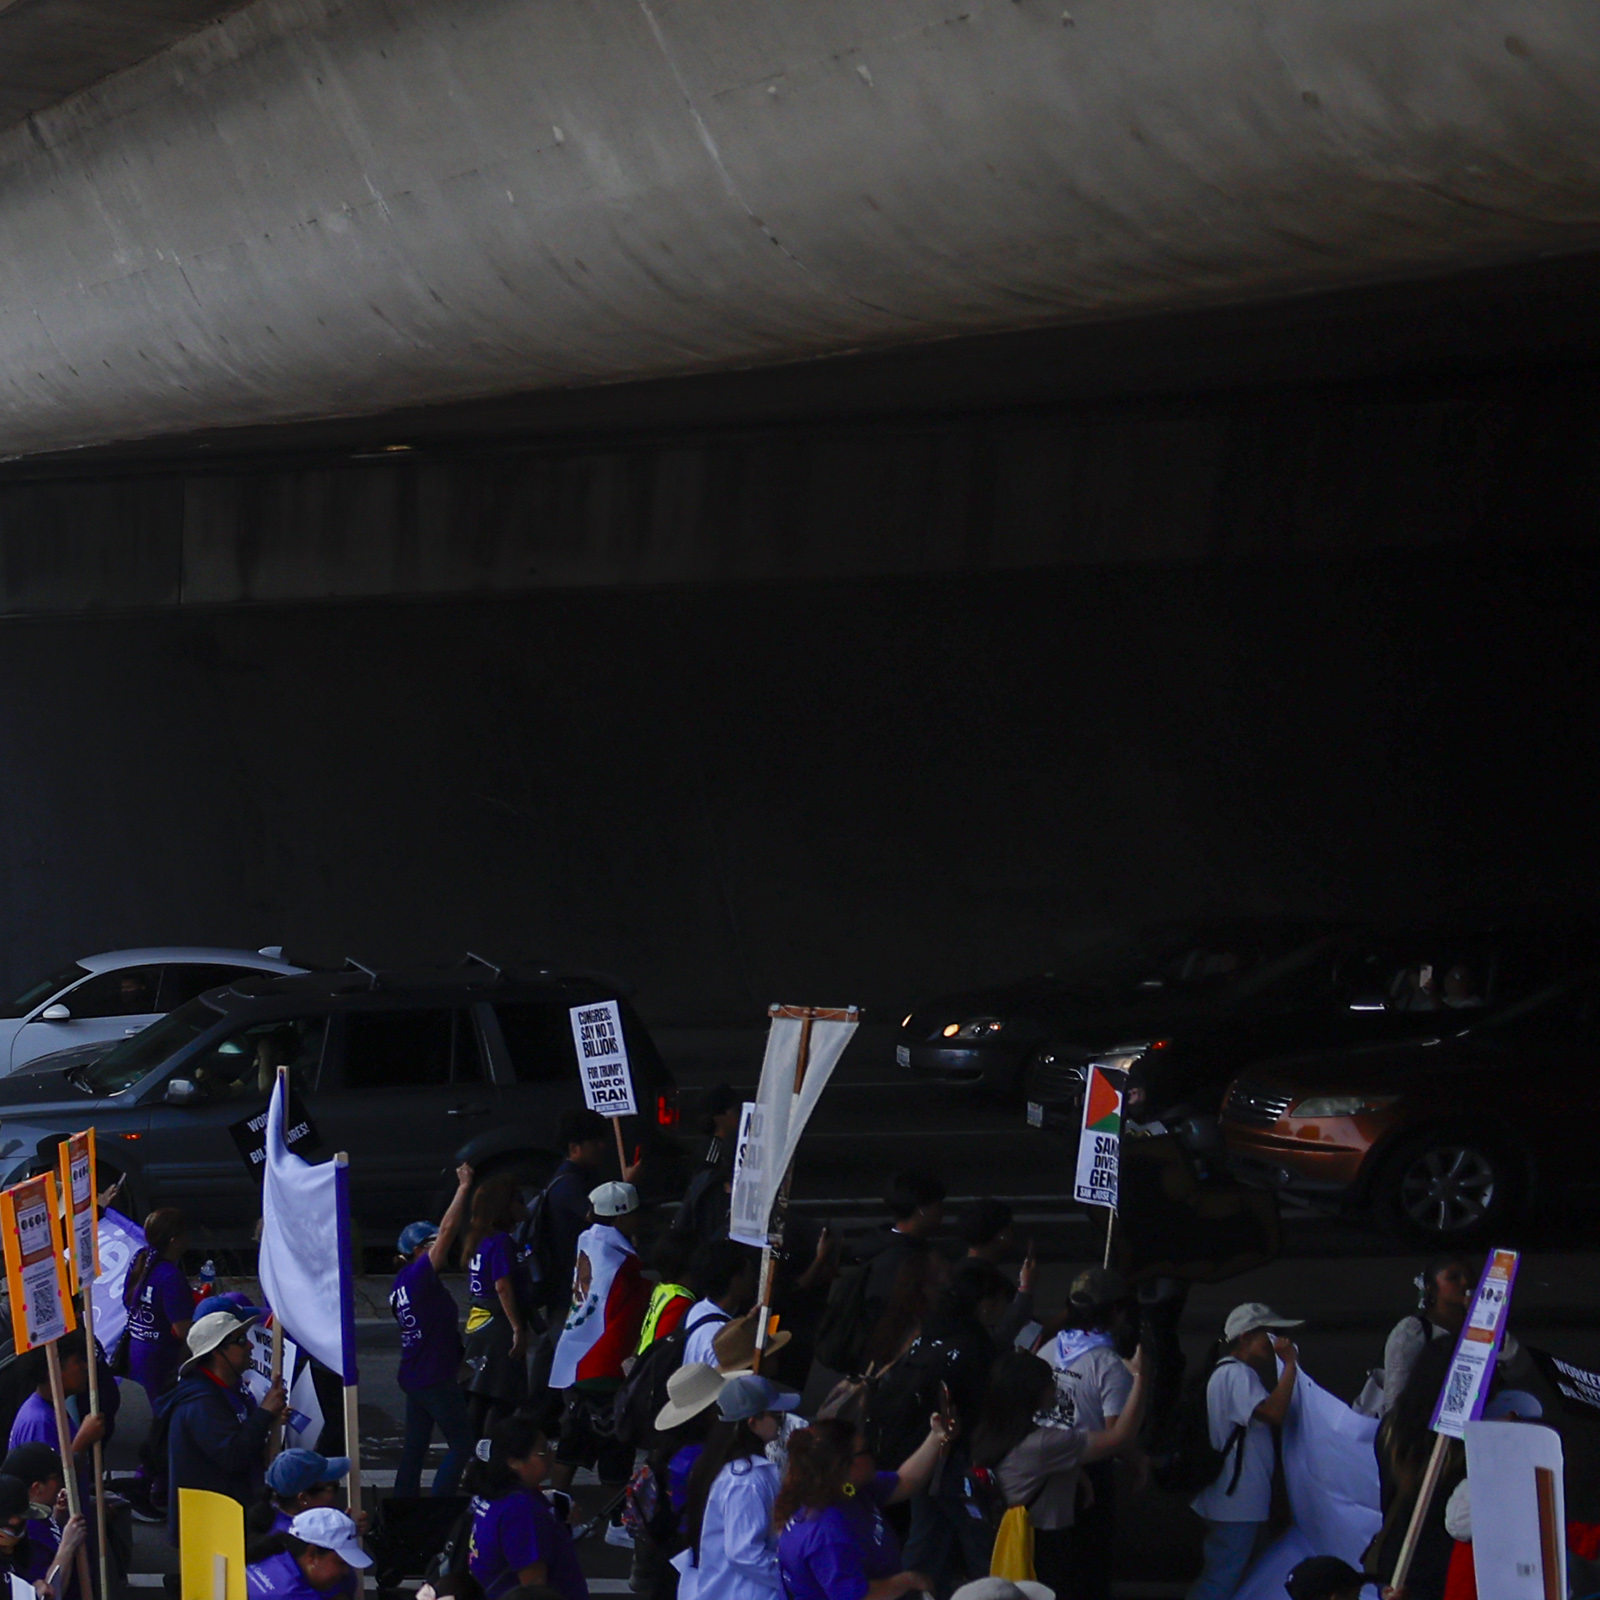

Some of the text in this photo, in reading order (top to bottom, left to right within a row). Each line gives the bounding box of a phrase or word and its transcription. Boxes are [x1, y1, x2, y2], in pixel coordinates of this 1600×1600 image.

[580, 1026, 595, 1041] SAY
[595, 1024, 607, 1038] NO
[583, 1040, 619, 1058] BILLIONS
[587, 1066, 598, 1080] FOR
[589, 1078, 625, 1090] WAR ON
[591, 1089, 628, 1104] IRAN
